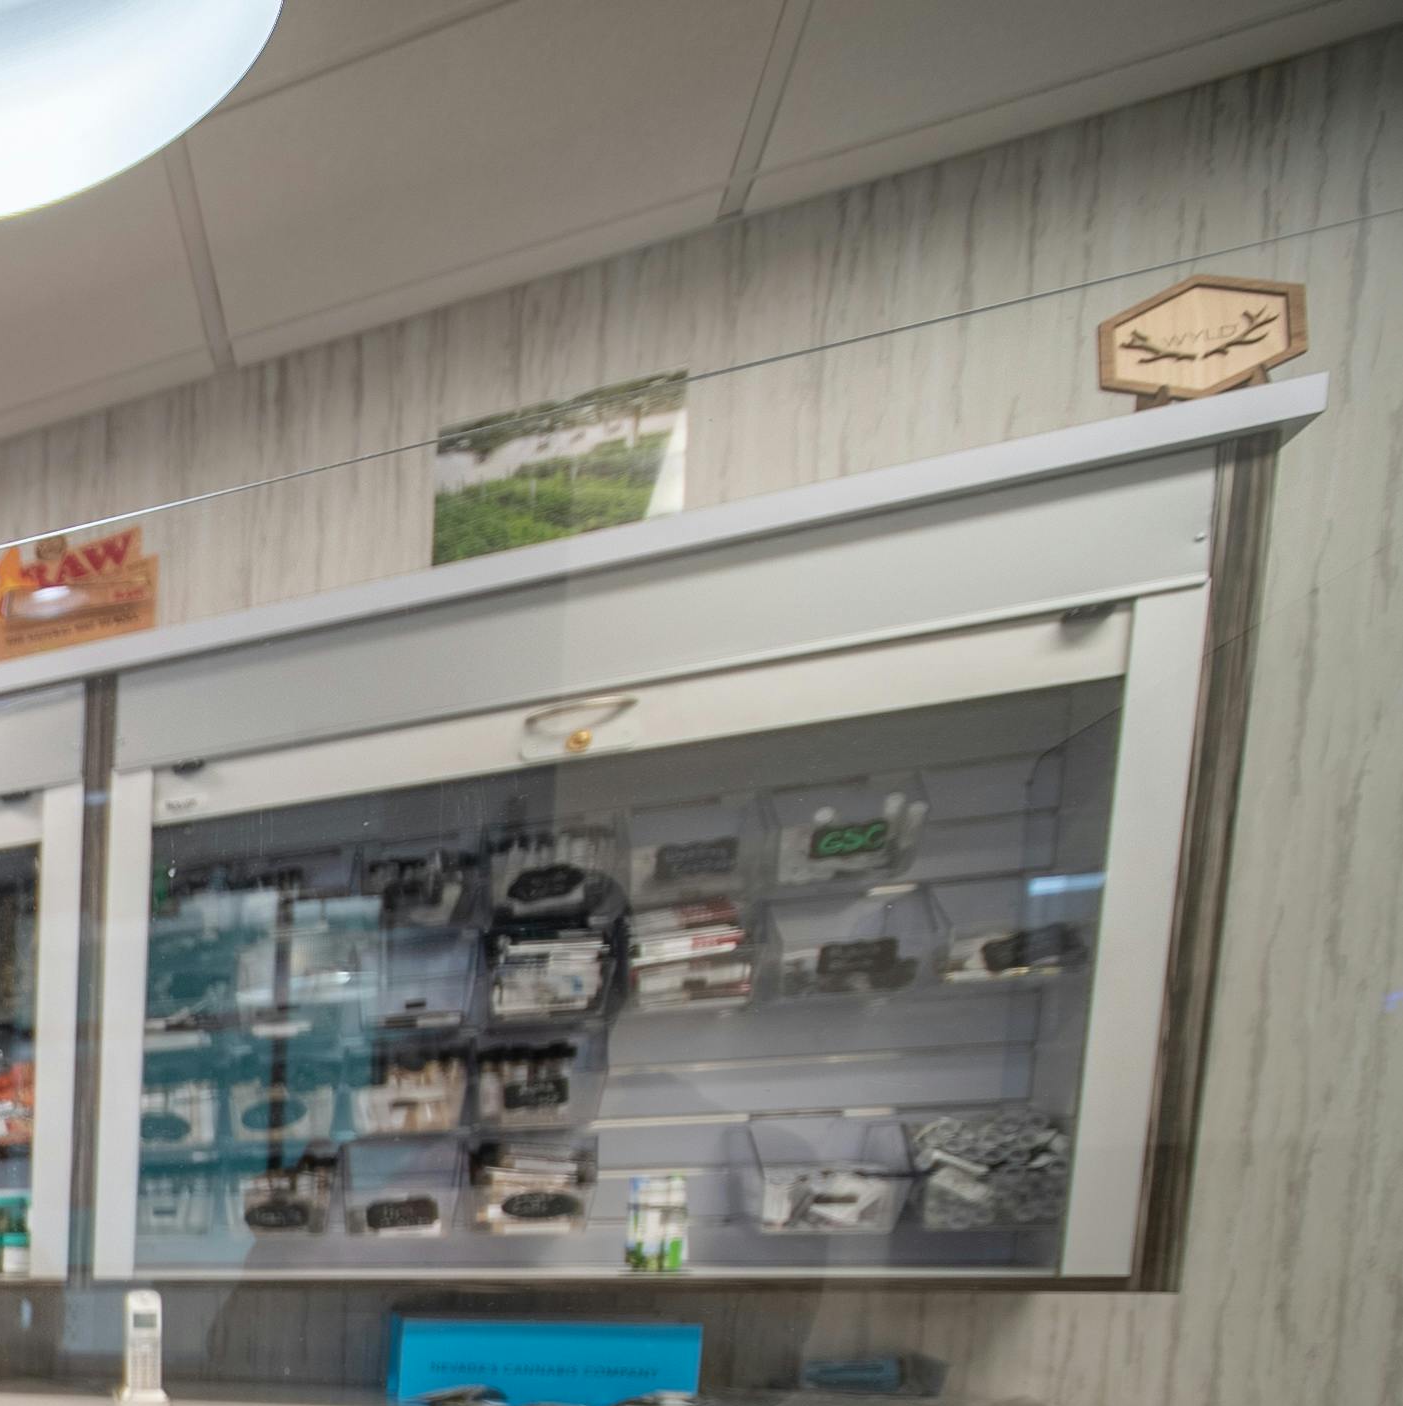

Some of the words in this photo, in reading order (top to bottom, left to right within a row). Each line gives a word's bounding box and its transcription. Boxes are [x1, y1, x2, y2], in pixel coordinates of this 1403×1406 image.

[1164, 324, 1238, 347] WYLD
[20, 532, 133, 588] RAW
[429, 1360, 498, 1377] NEVADA'S
[503, 1362, 578, 1378] CANNABIS
[583, 1364, 660, 1379] COMPANY
